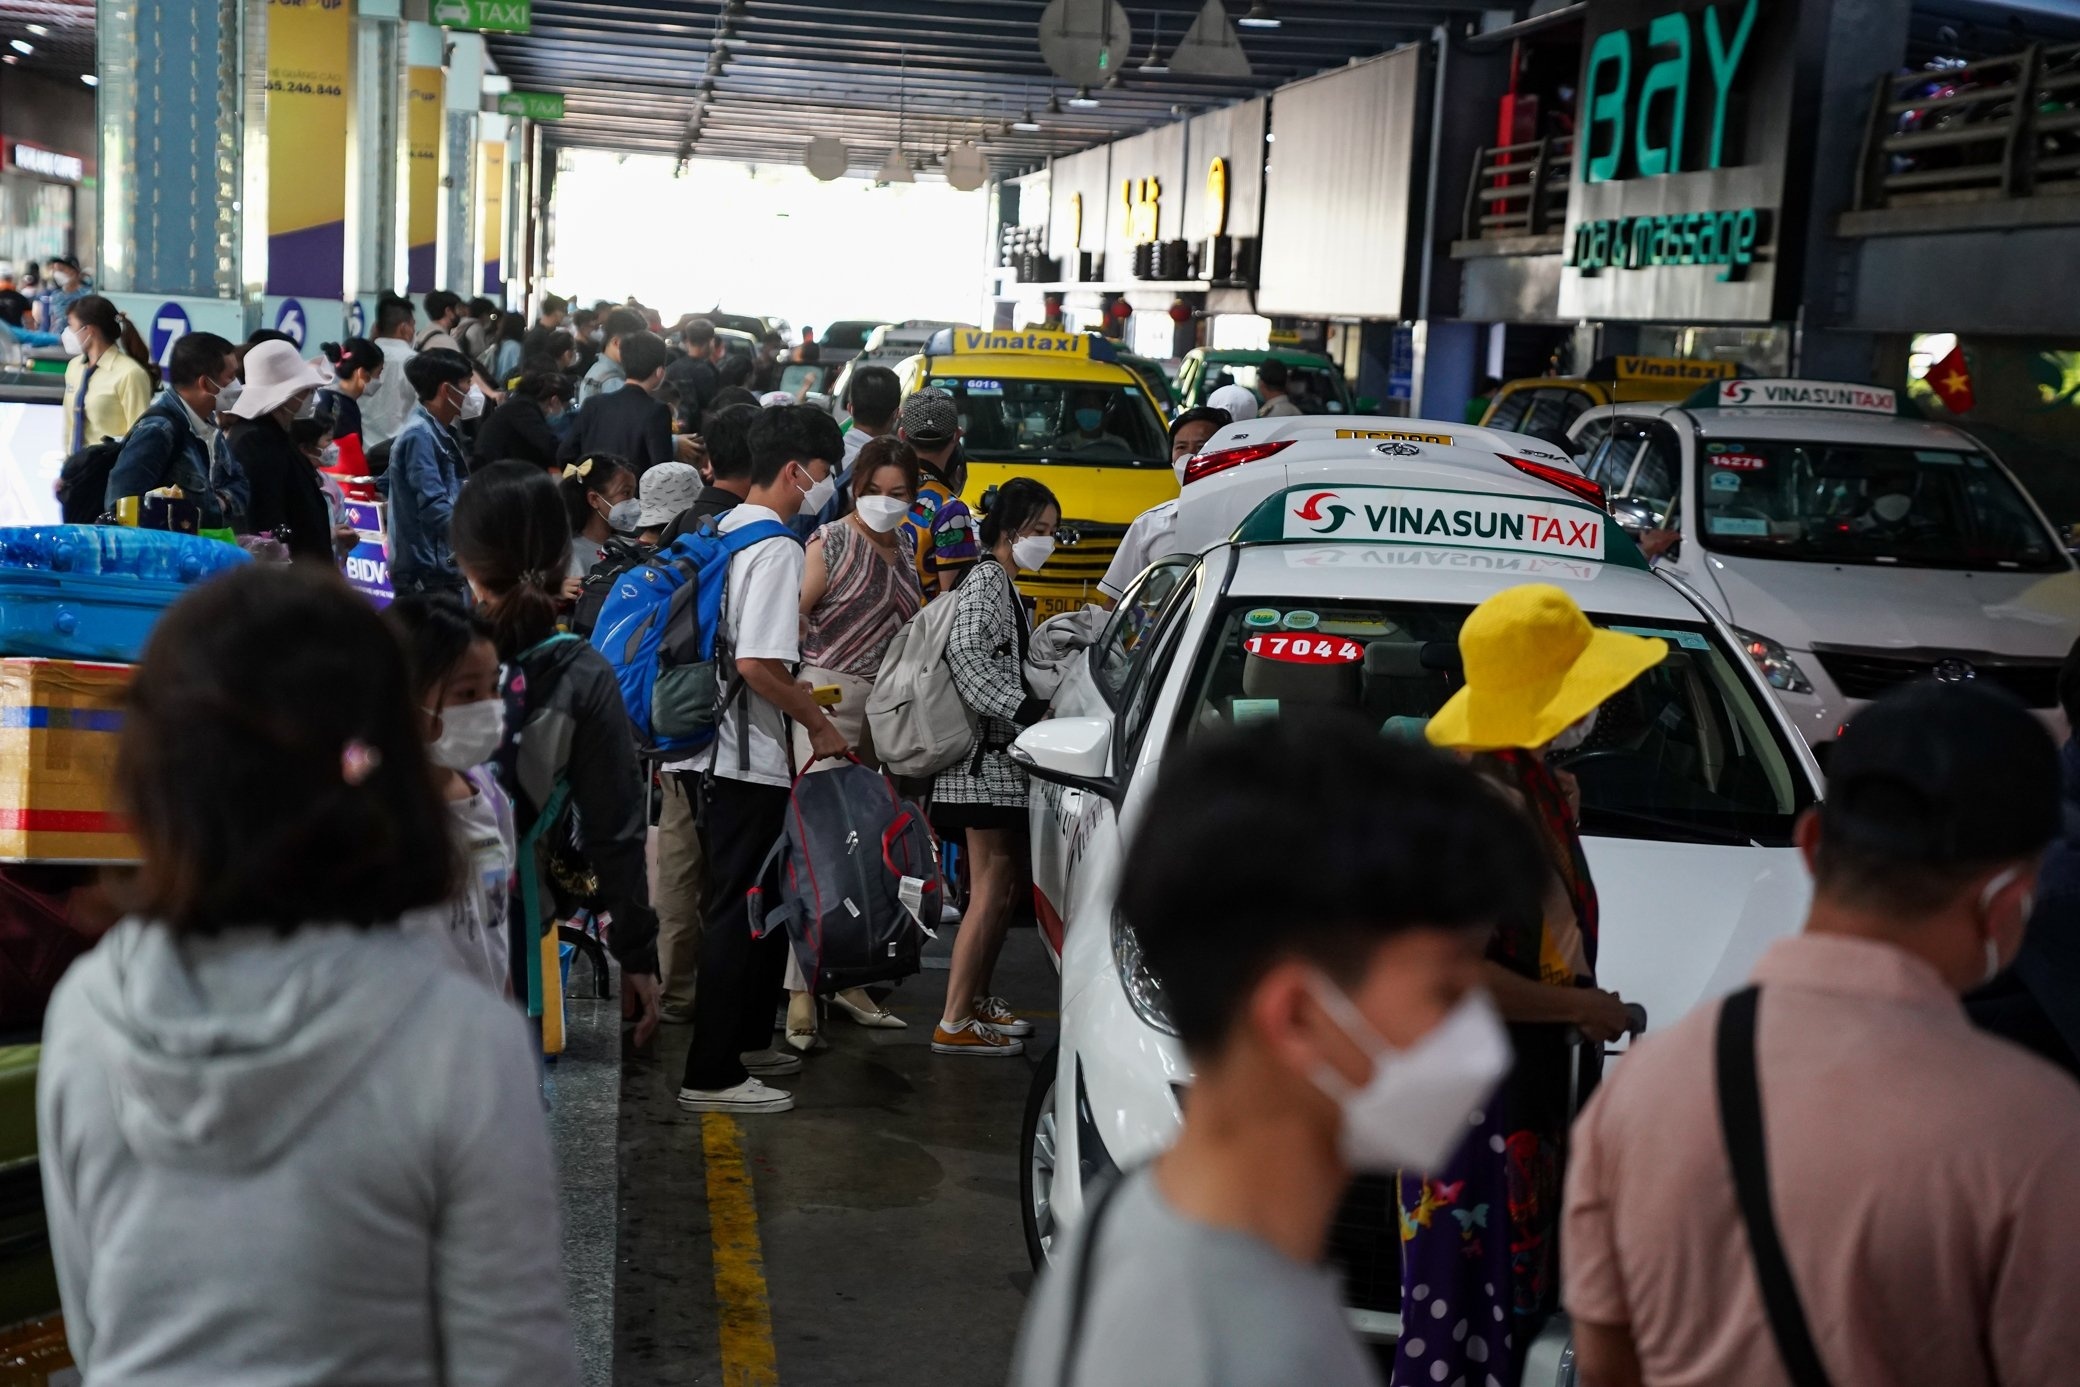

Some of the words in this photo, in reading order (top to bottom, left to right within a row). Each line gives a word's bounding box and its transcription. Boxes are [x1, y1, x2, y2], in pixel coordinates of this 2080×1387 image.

[474, 1, 526, 25] TAXI
[1631, 207, 1757, 283] massage
[157, 317, 186, 368] 7
[966, 332, 1079, 352] Vinataxi
[1625, 358, 1726, 378] Vinataxi
[967, 380, 999, 389] 6019
[346, 557, 387, 585] BIDV
[1249, 637, 1358, 660] 17044
